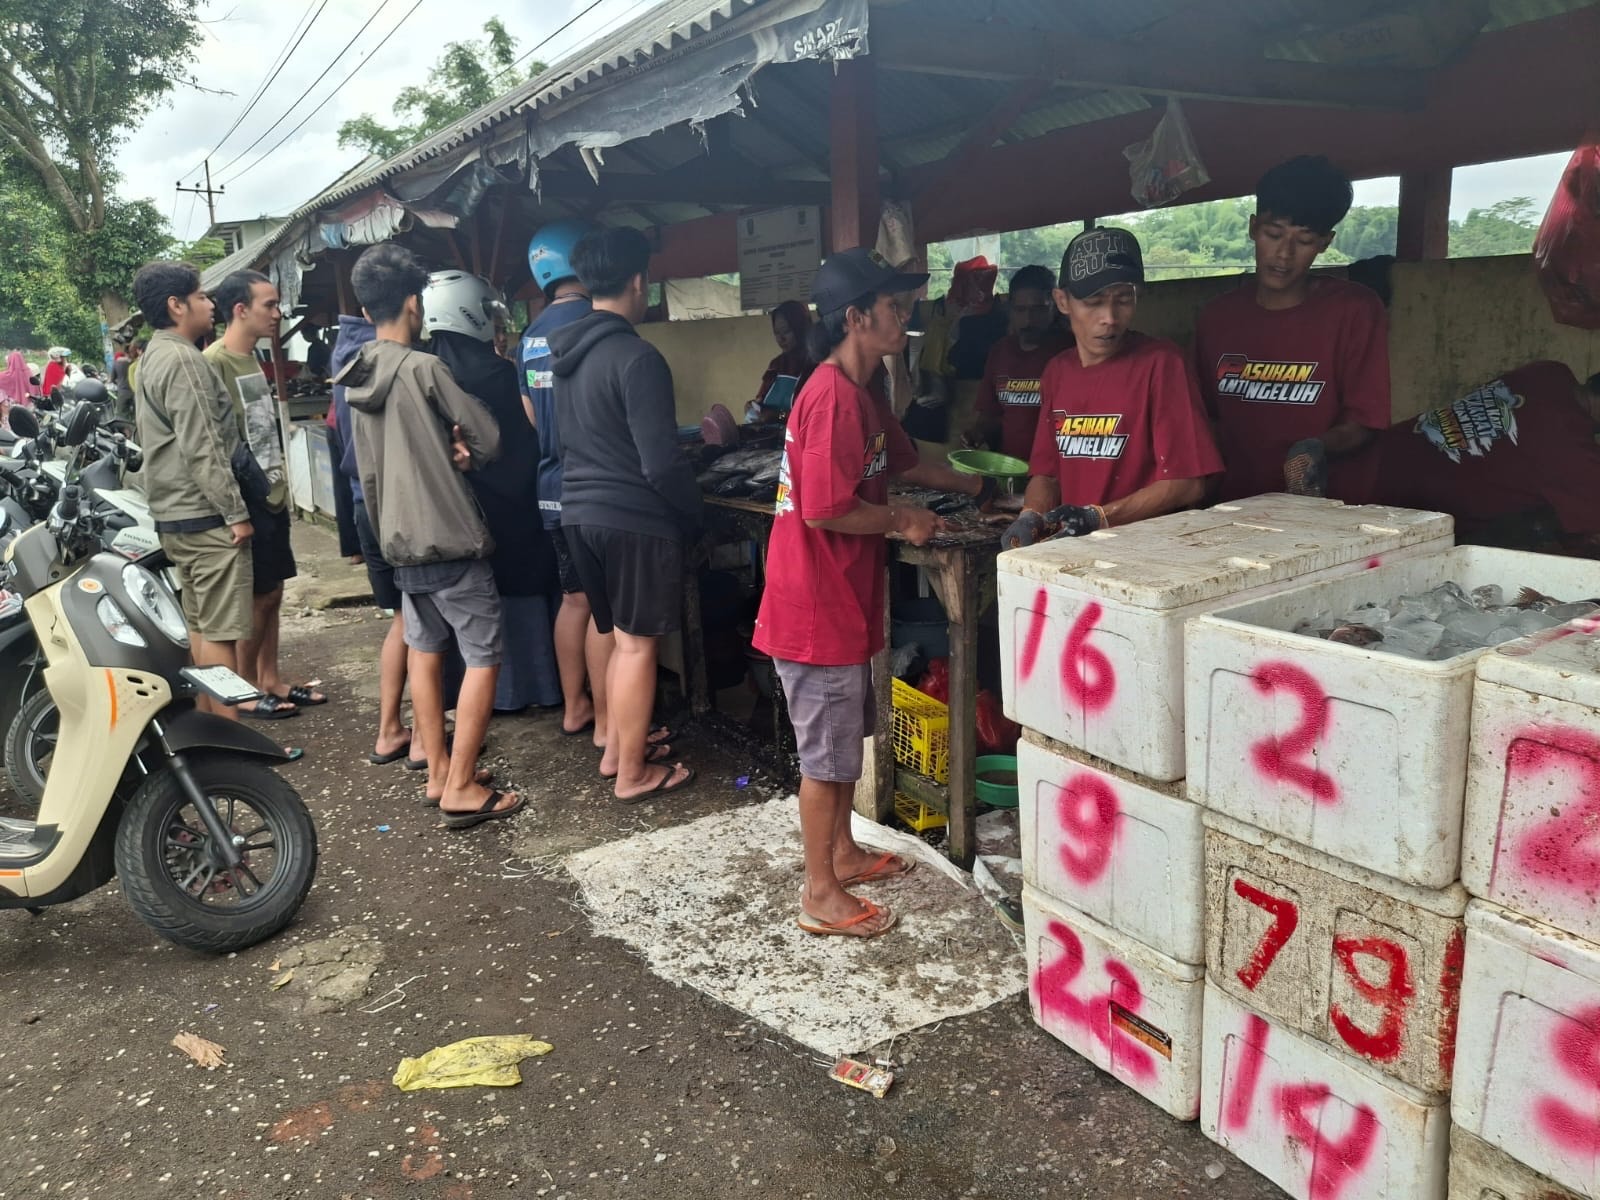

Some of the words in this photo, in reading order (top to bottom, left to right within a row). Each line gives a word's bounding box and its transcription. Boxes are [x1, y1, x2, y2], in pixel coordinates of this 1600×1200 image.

[1019, 586, 1117, 714] 16
[1249, 659, 1341, 806] 2
[1056, 772, 1124, 885] 9
